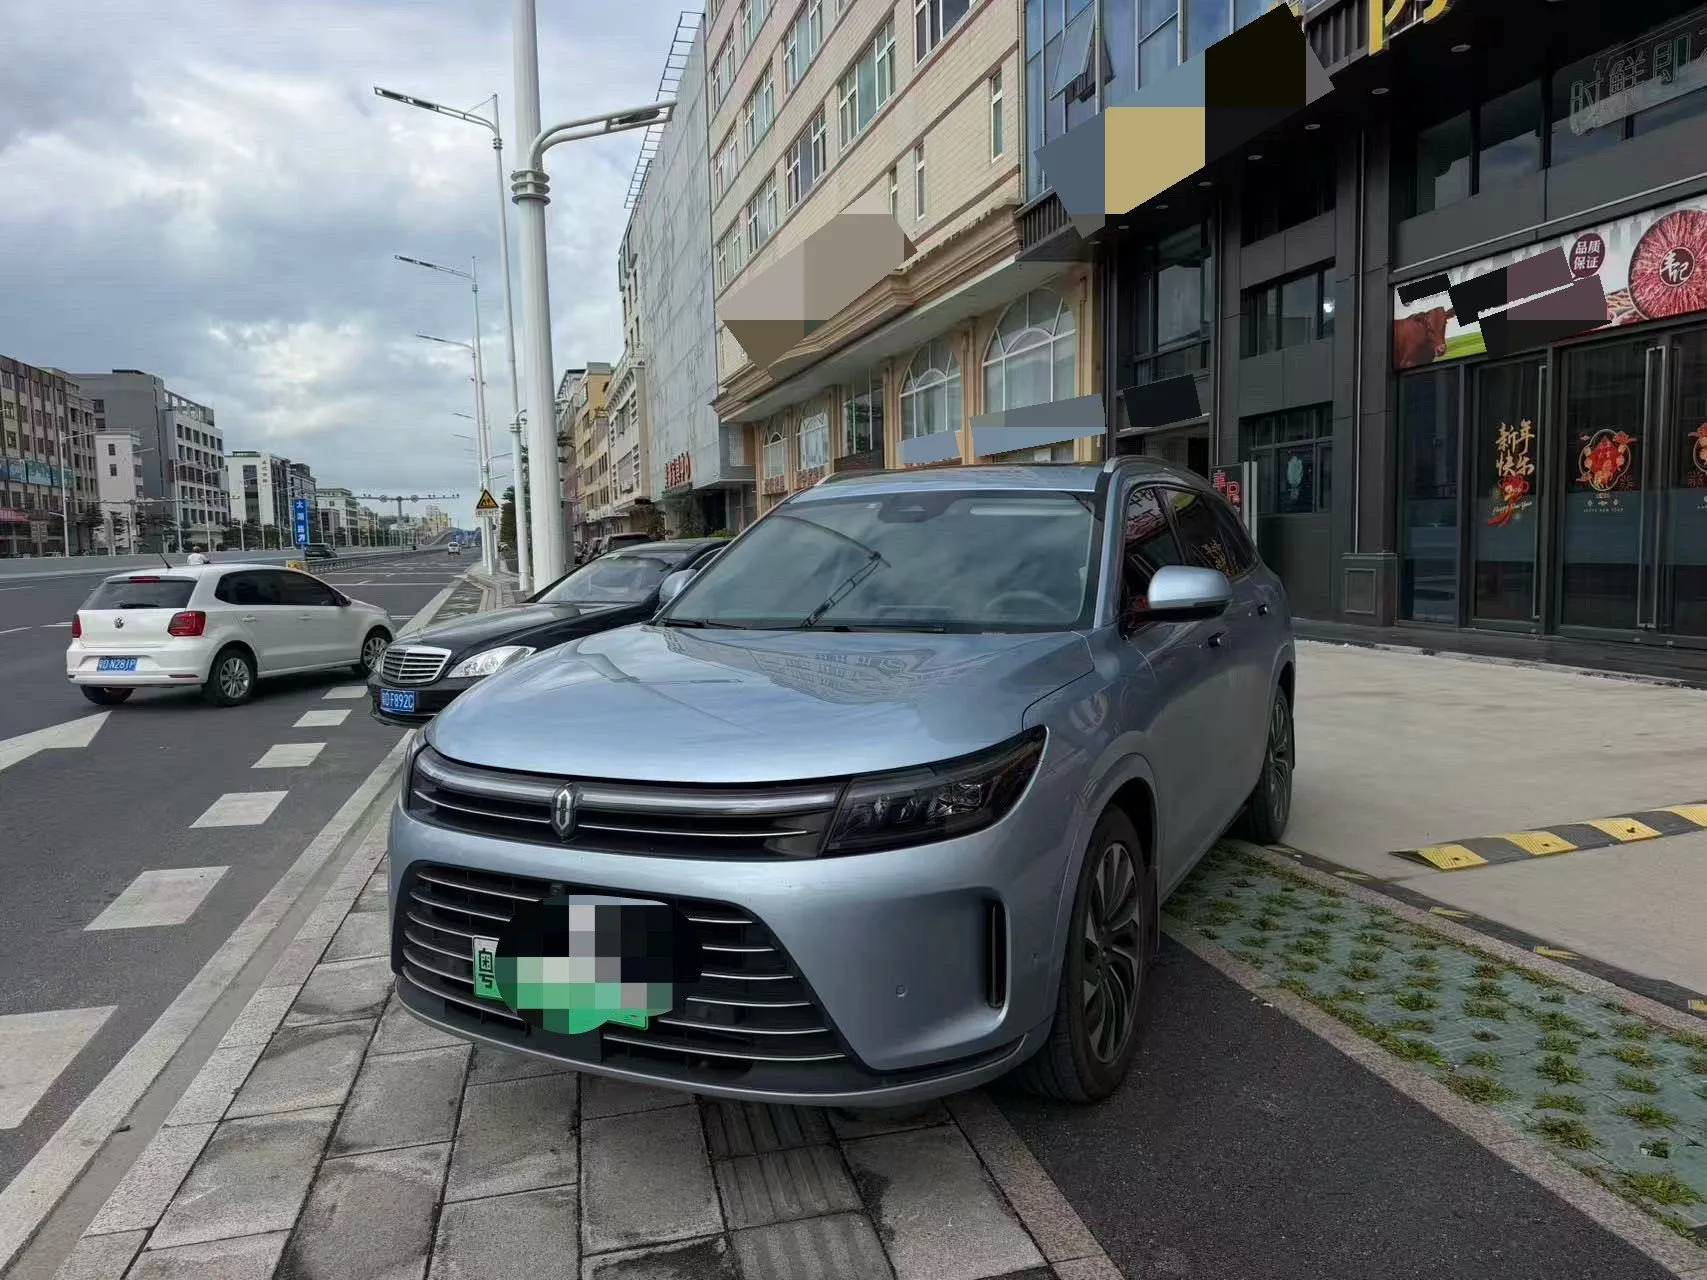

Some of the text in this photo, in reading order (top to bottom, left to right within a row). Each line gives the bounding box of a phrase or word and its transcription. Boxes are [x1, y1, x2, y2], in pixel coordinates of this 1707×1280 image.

[1575, 239, 1601, 254] 品质
[1573, 255, 1599, 270] 保证
[1495, 418, 1536, 457] 新年
[1495, 449, 1536, 477] 快乐
